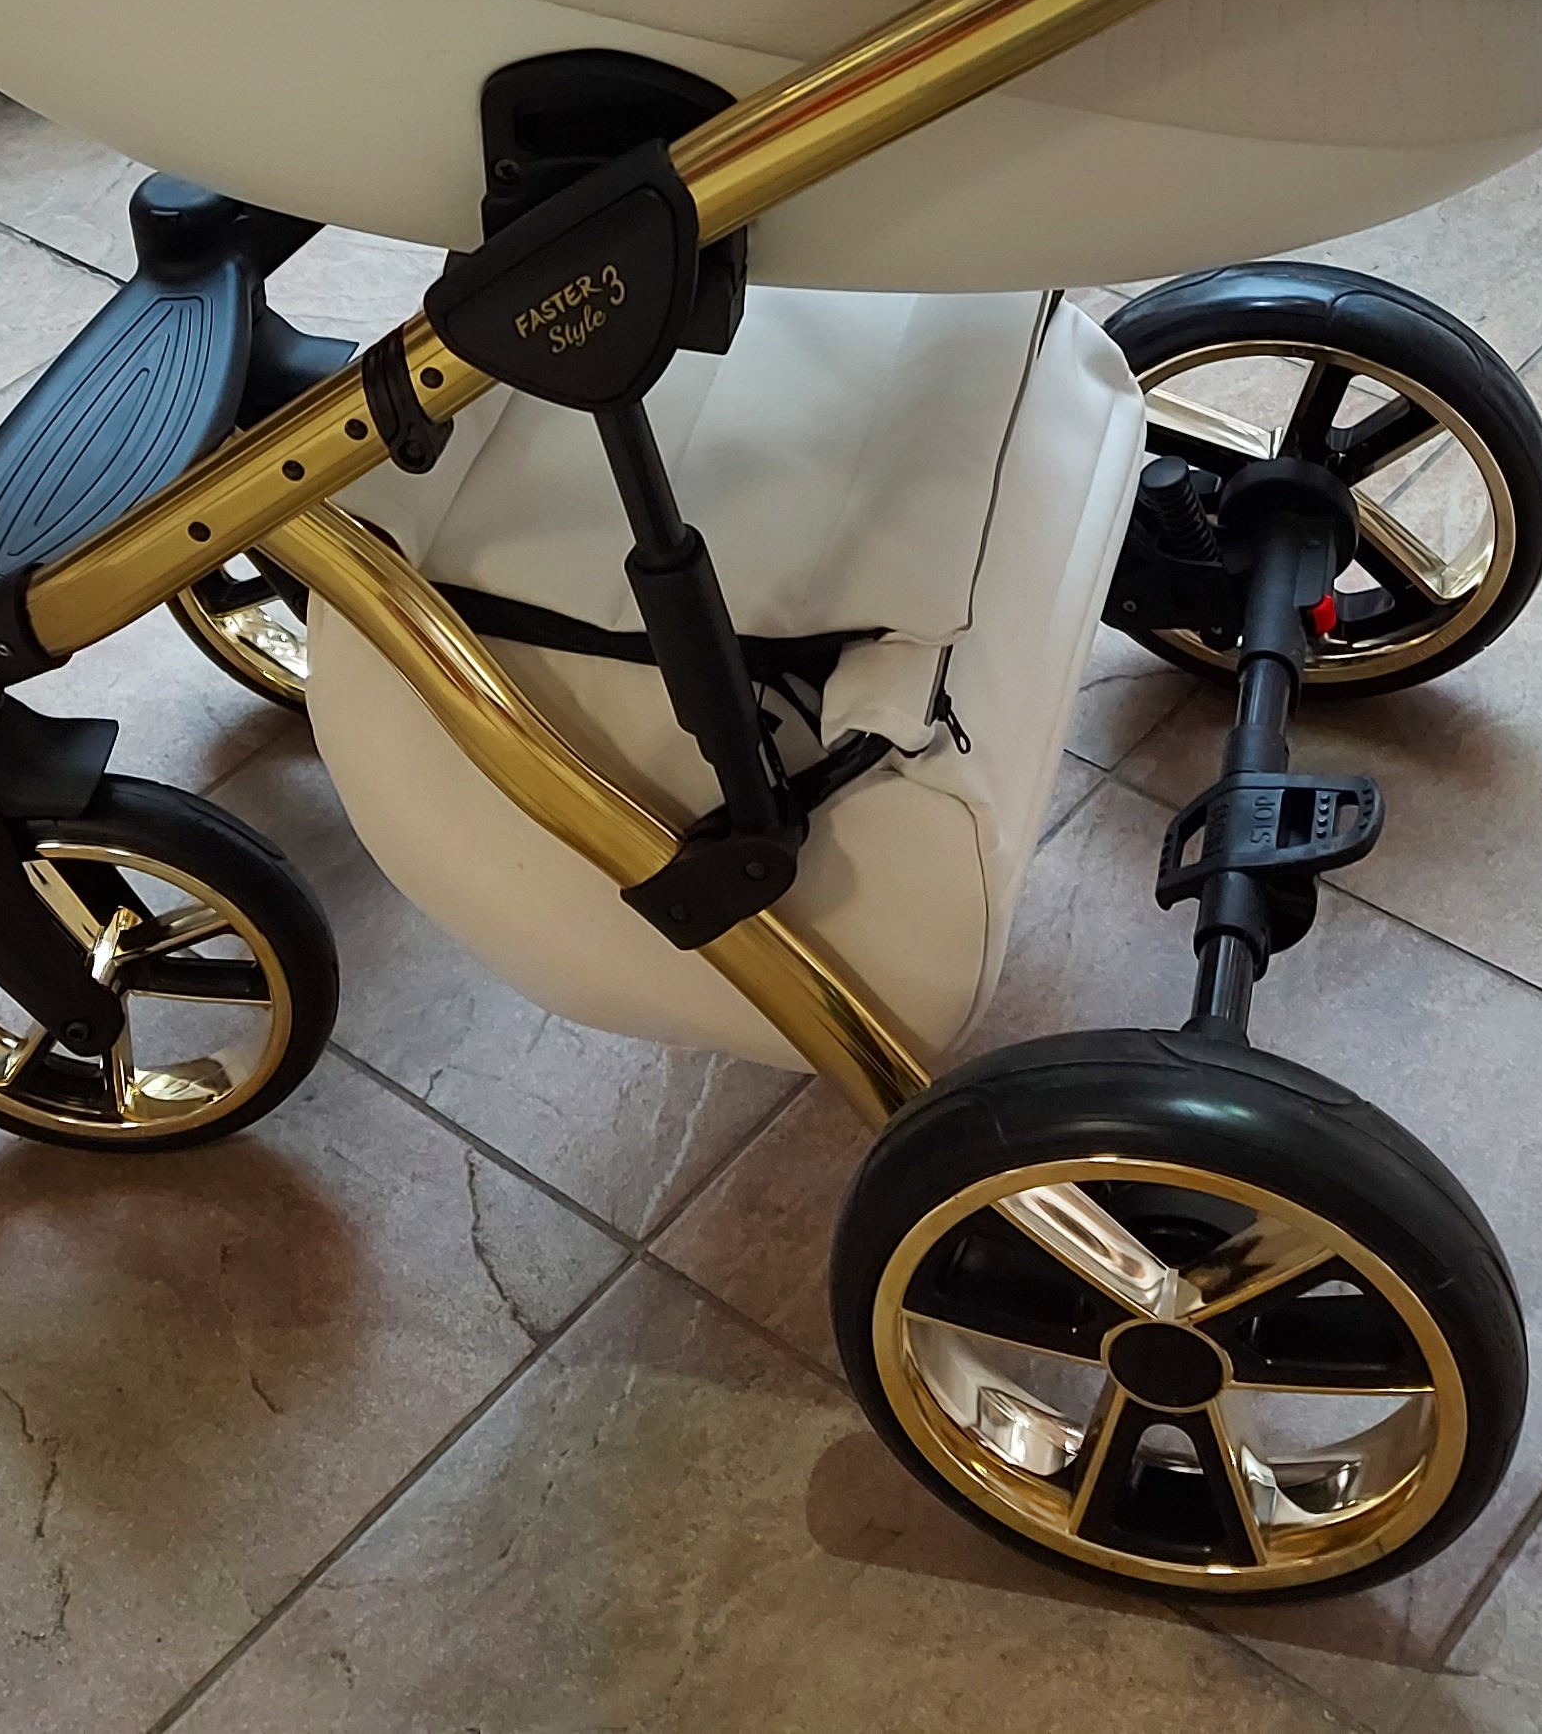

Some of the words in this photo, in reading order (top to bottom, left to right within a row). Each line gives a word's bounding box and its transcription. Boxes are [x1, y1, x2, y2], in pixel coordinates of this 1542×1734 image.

[514, 275, 603, 339] FASTER
[602, 264, 625, 306] 3
[548, 304, 606, 354] Style
[1250, 795, 1276, 844] STOP
